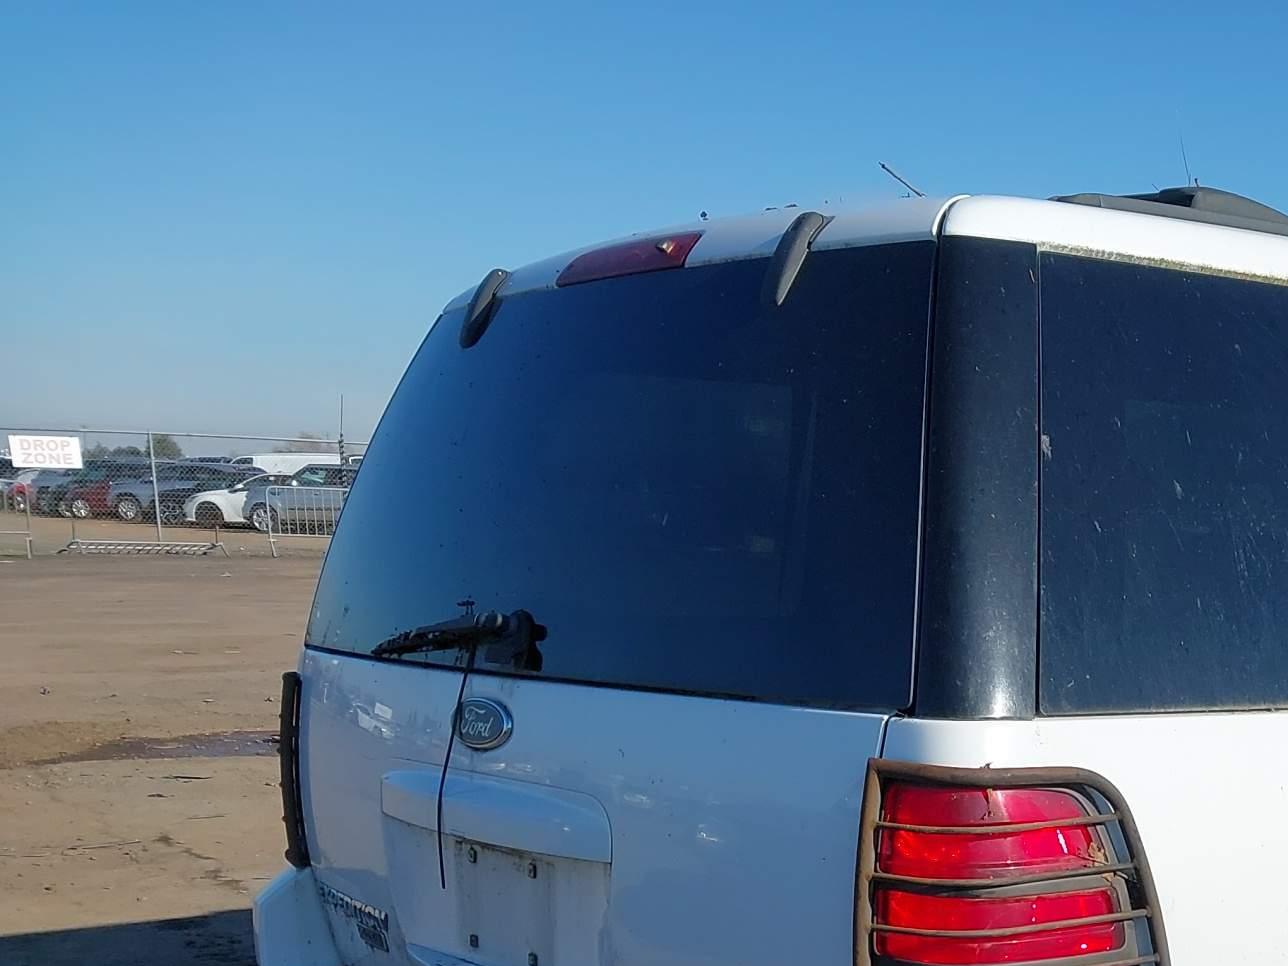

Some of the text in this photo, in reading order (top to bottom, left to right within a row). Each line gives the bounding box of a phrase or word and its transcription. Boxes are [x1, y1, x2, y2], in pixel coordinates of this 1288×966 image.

[19, 438, 71, 452] DROP
[21, 452, 74, 465] ZONE
[461, 706, 494, 737] Ford
